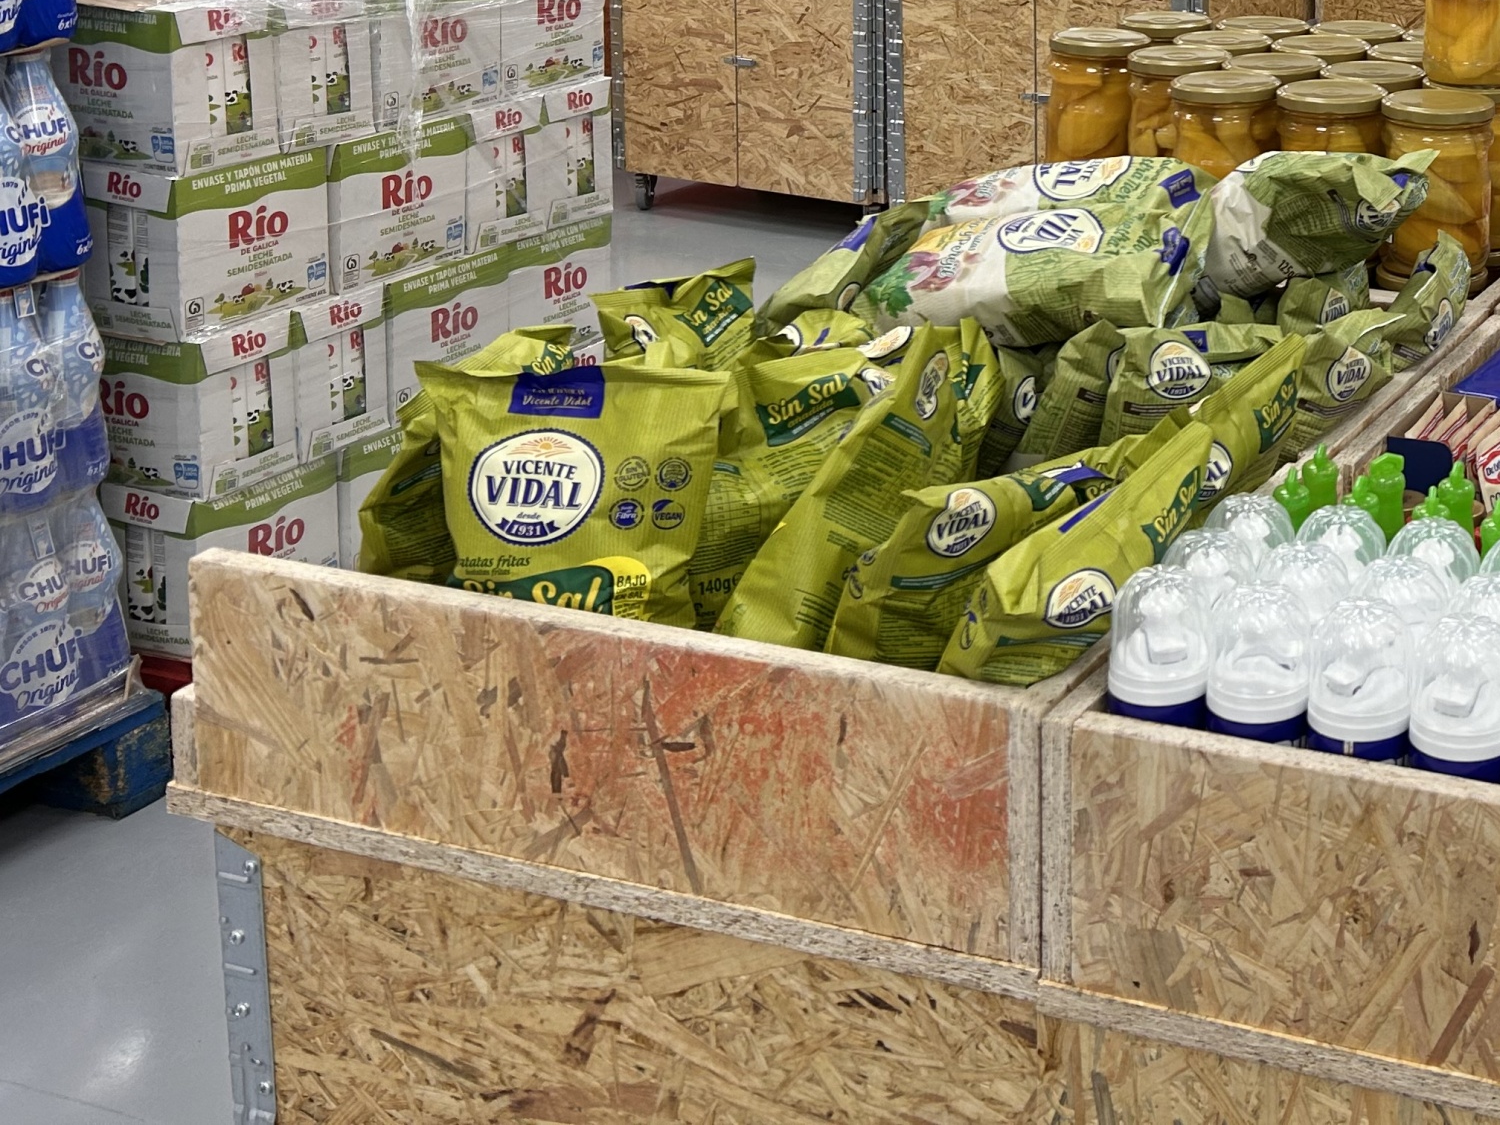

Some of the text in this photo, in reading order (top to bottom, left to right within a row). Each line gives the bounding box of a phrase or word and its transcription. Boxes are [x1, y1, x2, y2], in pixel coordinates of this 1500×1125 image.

[68, 47, 127, 90] Río
[92, 89, 117, 98] GALICIA
[87, 98, 112, 108] LECHE
[192, 153, 313, 190] ENVASE Y TAPÓN CON MATERIA
[107, 171, 141, 199] Río
[225, 171, 286, 195] PRIMA VEGETAL
[228, 205, 288, 249] Río
[380, 214, 435, 236] SEMIDESNATADA
[253, 240, 279, 253] GALICIA
[248, 250, 273, 262] LECHE
[227, 252, 293, 277] SEMIDESNATADA
[1160, 357, 1194, 368] VICENTE
[1156, 366, 1205, 382] VIDAL
[522, 395, 592, 407] Vicente Vidal
[768, 375, 847, 425] Sin Sal
[503, 460, 577, 479] VICENTE
[486, 476, 582, 510] VIDAL
[516, 512, 541, 520] desde
[654, 512, 683, 521] VEGAN
[511, 523, 541, 536] 1931
[497, 555, 531, 571] fritas
[616, 574, 647, 587] BAJO
[698, 578, 731, 595] 140g
